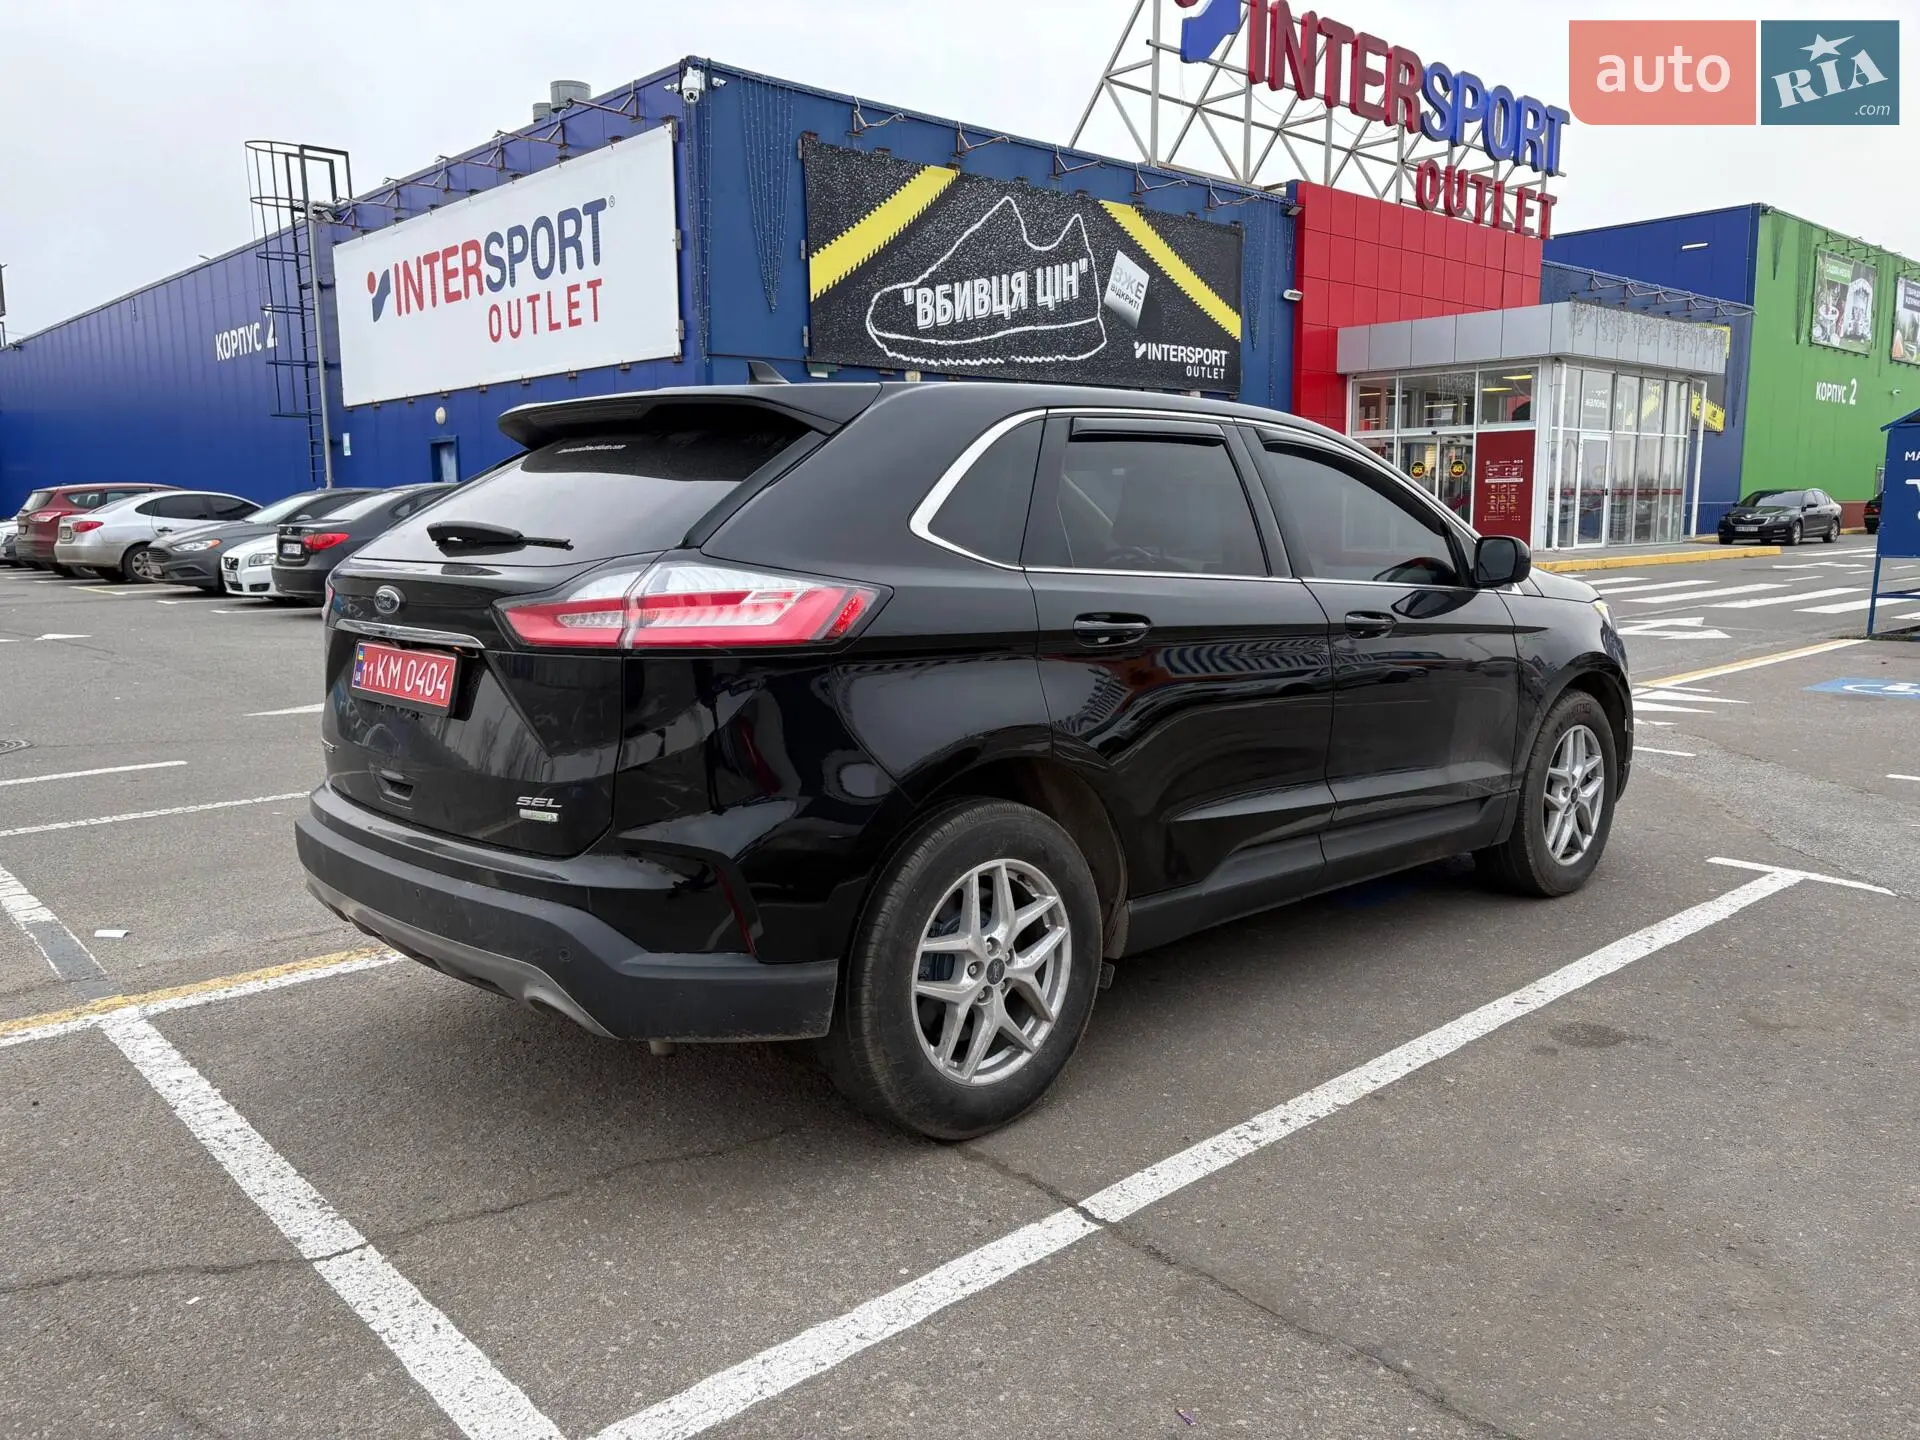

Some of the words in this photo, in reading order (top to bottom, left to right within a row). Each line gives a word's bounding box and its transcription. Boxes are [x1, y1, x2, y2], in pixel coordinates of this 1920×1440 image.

[1248, 0, 1570, 177] INTERSPORT
[1416, 158, 1558, 240] OUTLET
[394, 198, 607, 316] INTERSPORT
[1113, 265, 1144, 300] ВЖЕ
[489, 278, 602, 343] OUTLET
[903, 270, 1028, 330] "ВБИВЦЯ
[1036, 258, 1088, 311] ЦІН"
[215, 322, 262, 361] КОРПУС
[264, 303, 278, 348] 2
[1148, 342, 1228, 366] INTERSPORT
[1186, 365, 1225, 379] OUTLET
[1815, 381, 1847, 404] КОРПУС
[1849, 378, 1857, 405] 2
[516, 796, 562, 807] SEL
